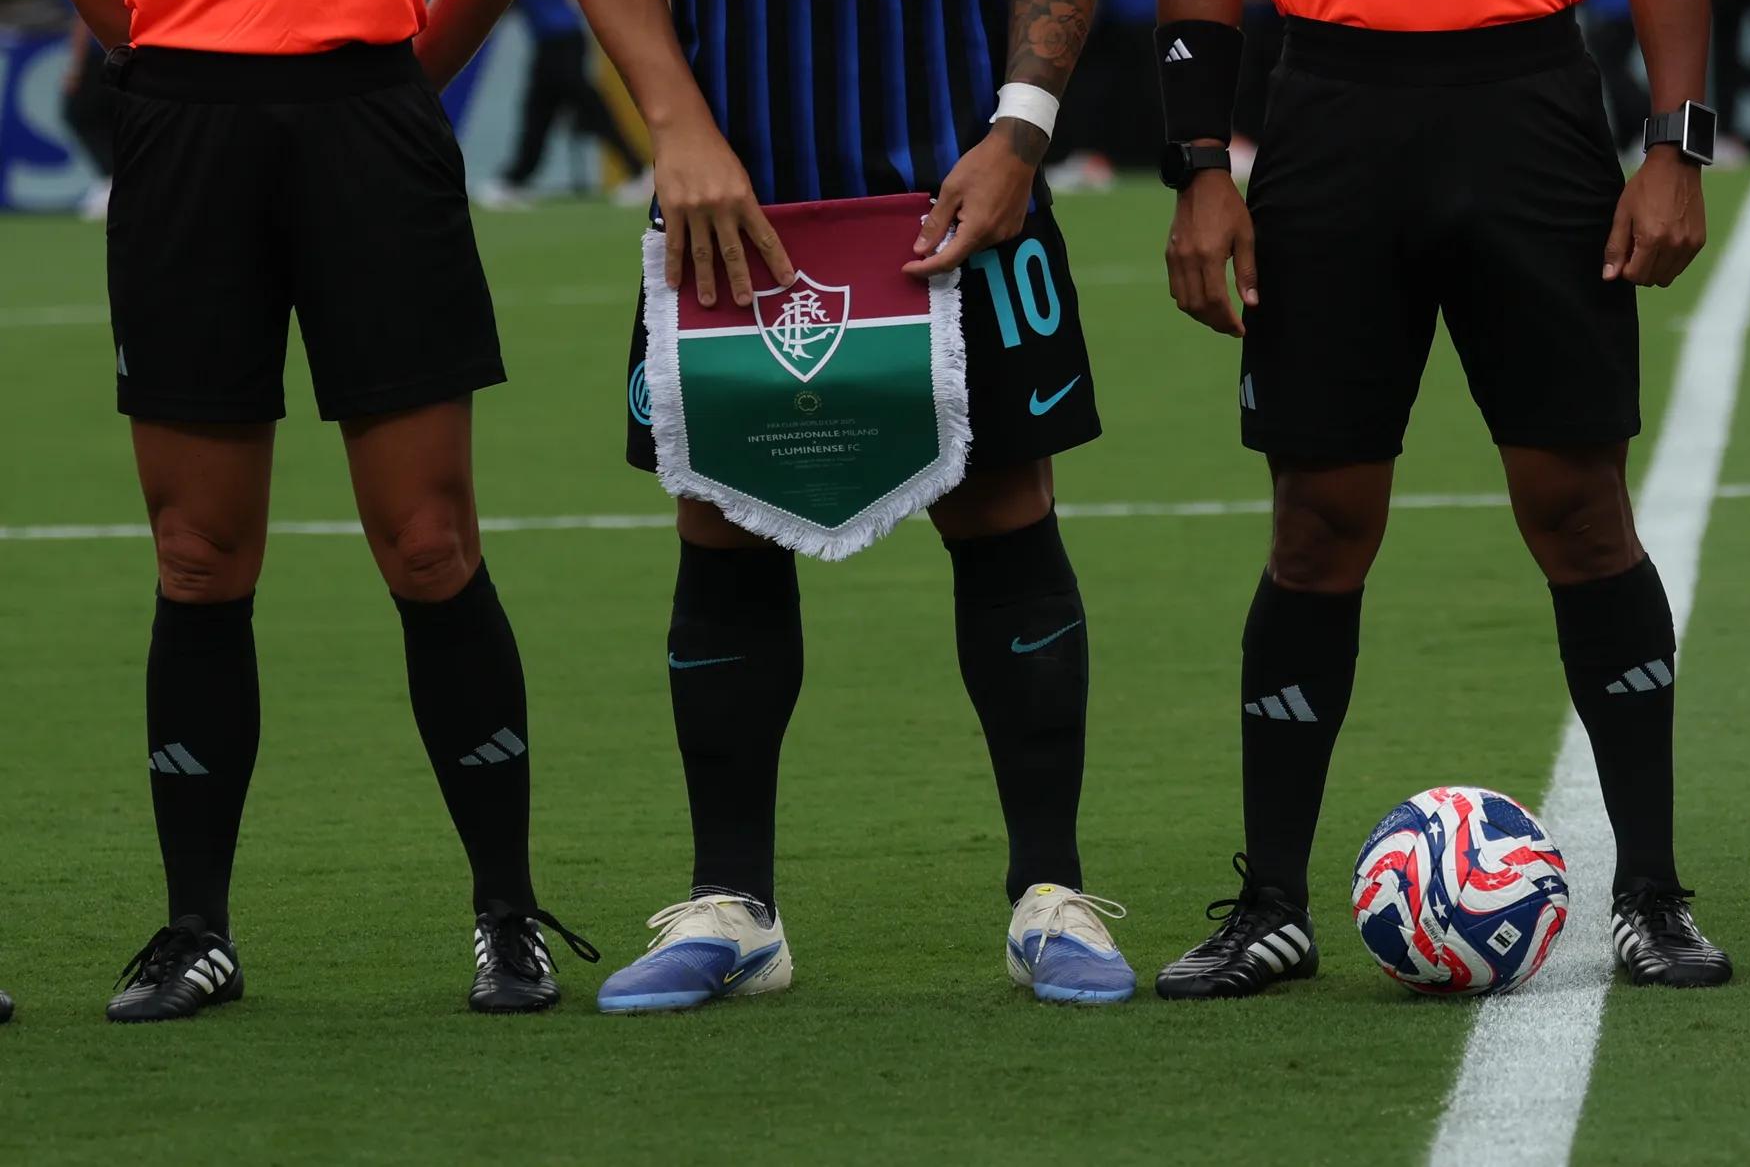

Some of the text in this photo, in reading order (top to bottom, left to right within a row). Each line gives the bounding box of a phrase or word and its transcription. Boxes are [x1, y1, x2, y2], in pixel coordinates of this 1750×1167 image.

[968, 237, 1061, 349] 10
[748, 428, 879, 443] INTERNAZIONALE MILANO
[771, 443, 860, 456] FLUMINENSE FC
